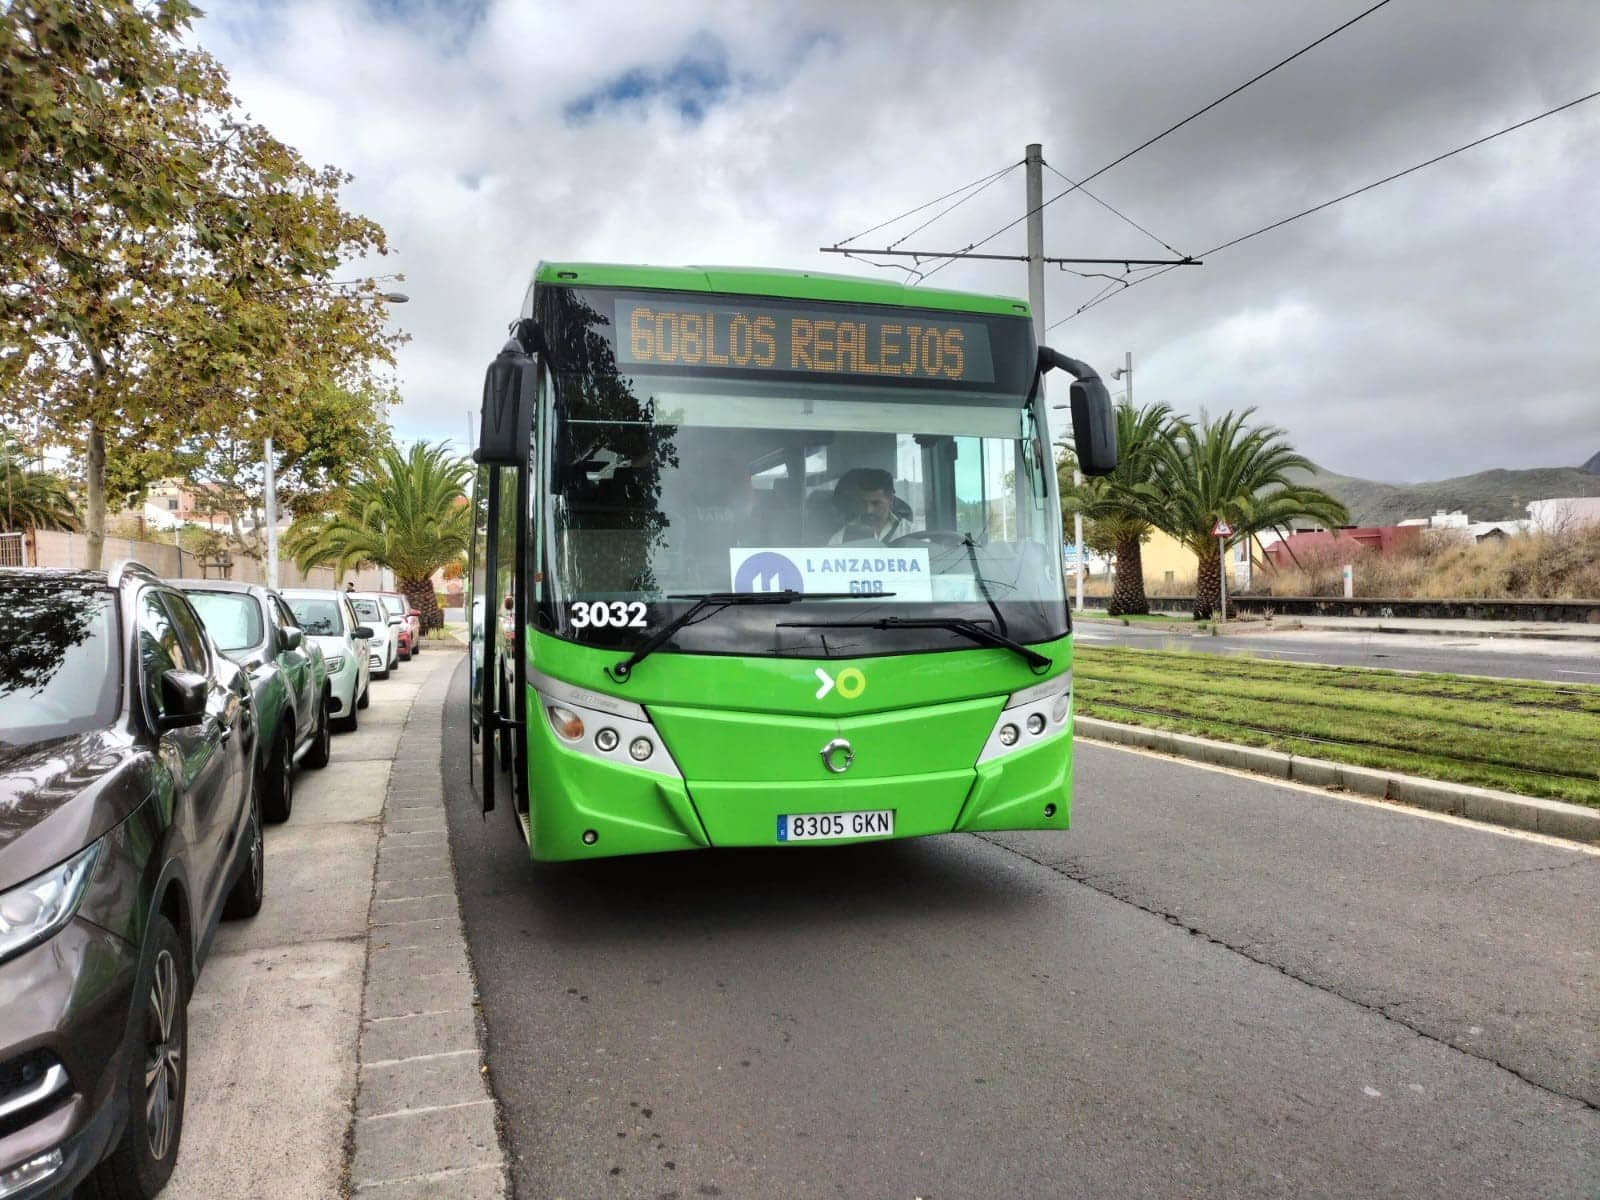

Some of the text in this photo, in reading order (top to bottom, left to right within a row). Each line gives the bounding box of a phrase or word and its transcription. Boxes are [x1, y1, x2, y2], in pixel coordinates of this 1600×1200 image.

[791, 318, 965, 379] REALEJOS
[849, 580, 883, 593] 608
[570, 601, 648, 628] 3032
[793, 815, 844, 837] 8305
[852, 812, 889, 834] GKN
